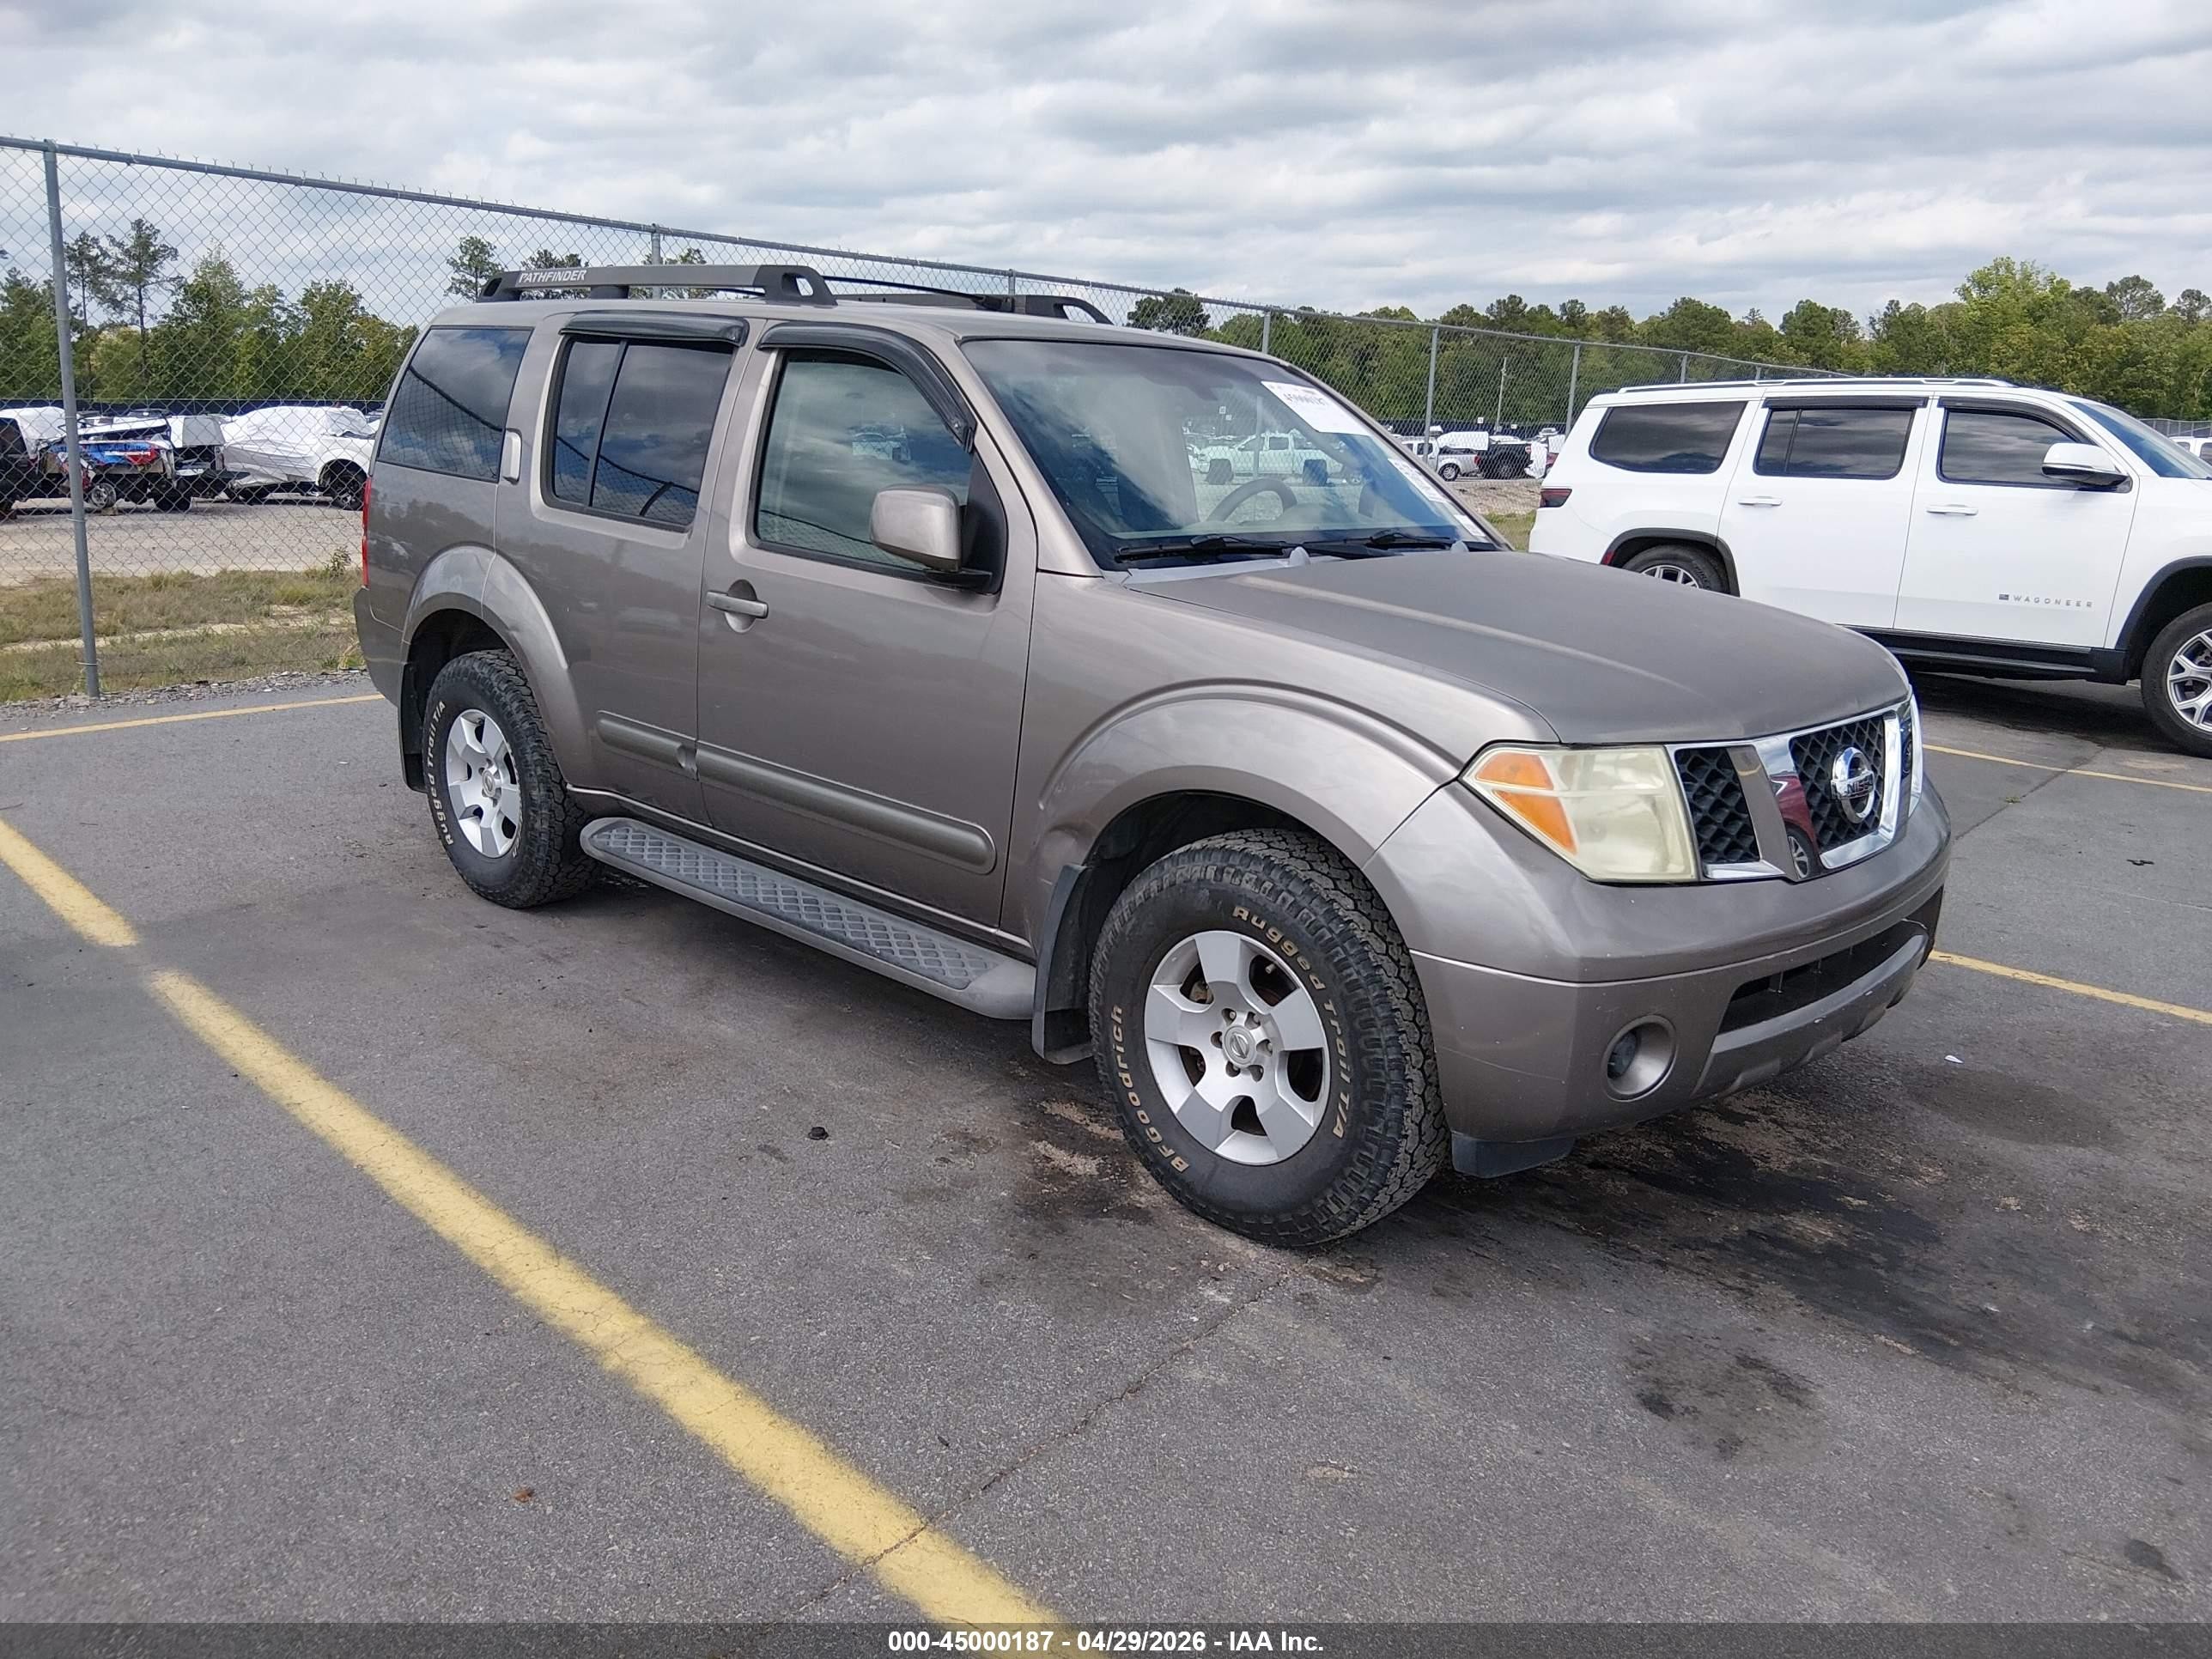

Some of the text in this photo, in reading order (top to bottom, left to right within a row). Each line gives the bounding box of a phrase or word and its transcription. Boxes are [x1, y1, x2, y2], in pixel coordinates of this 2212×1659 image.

[518, 269, 587, 283] PATHFINDER
[2013, 595, 2093, 608] WAGONEER
[433, 701, 446, 722] T/A
[1232, 906, 1352, 1139] Rugged Trail T/A
[1111, 1005, 1189, 1173] BFGoodrich
